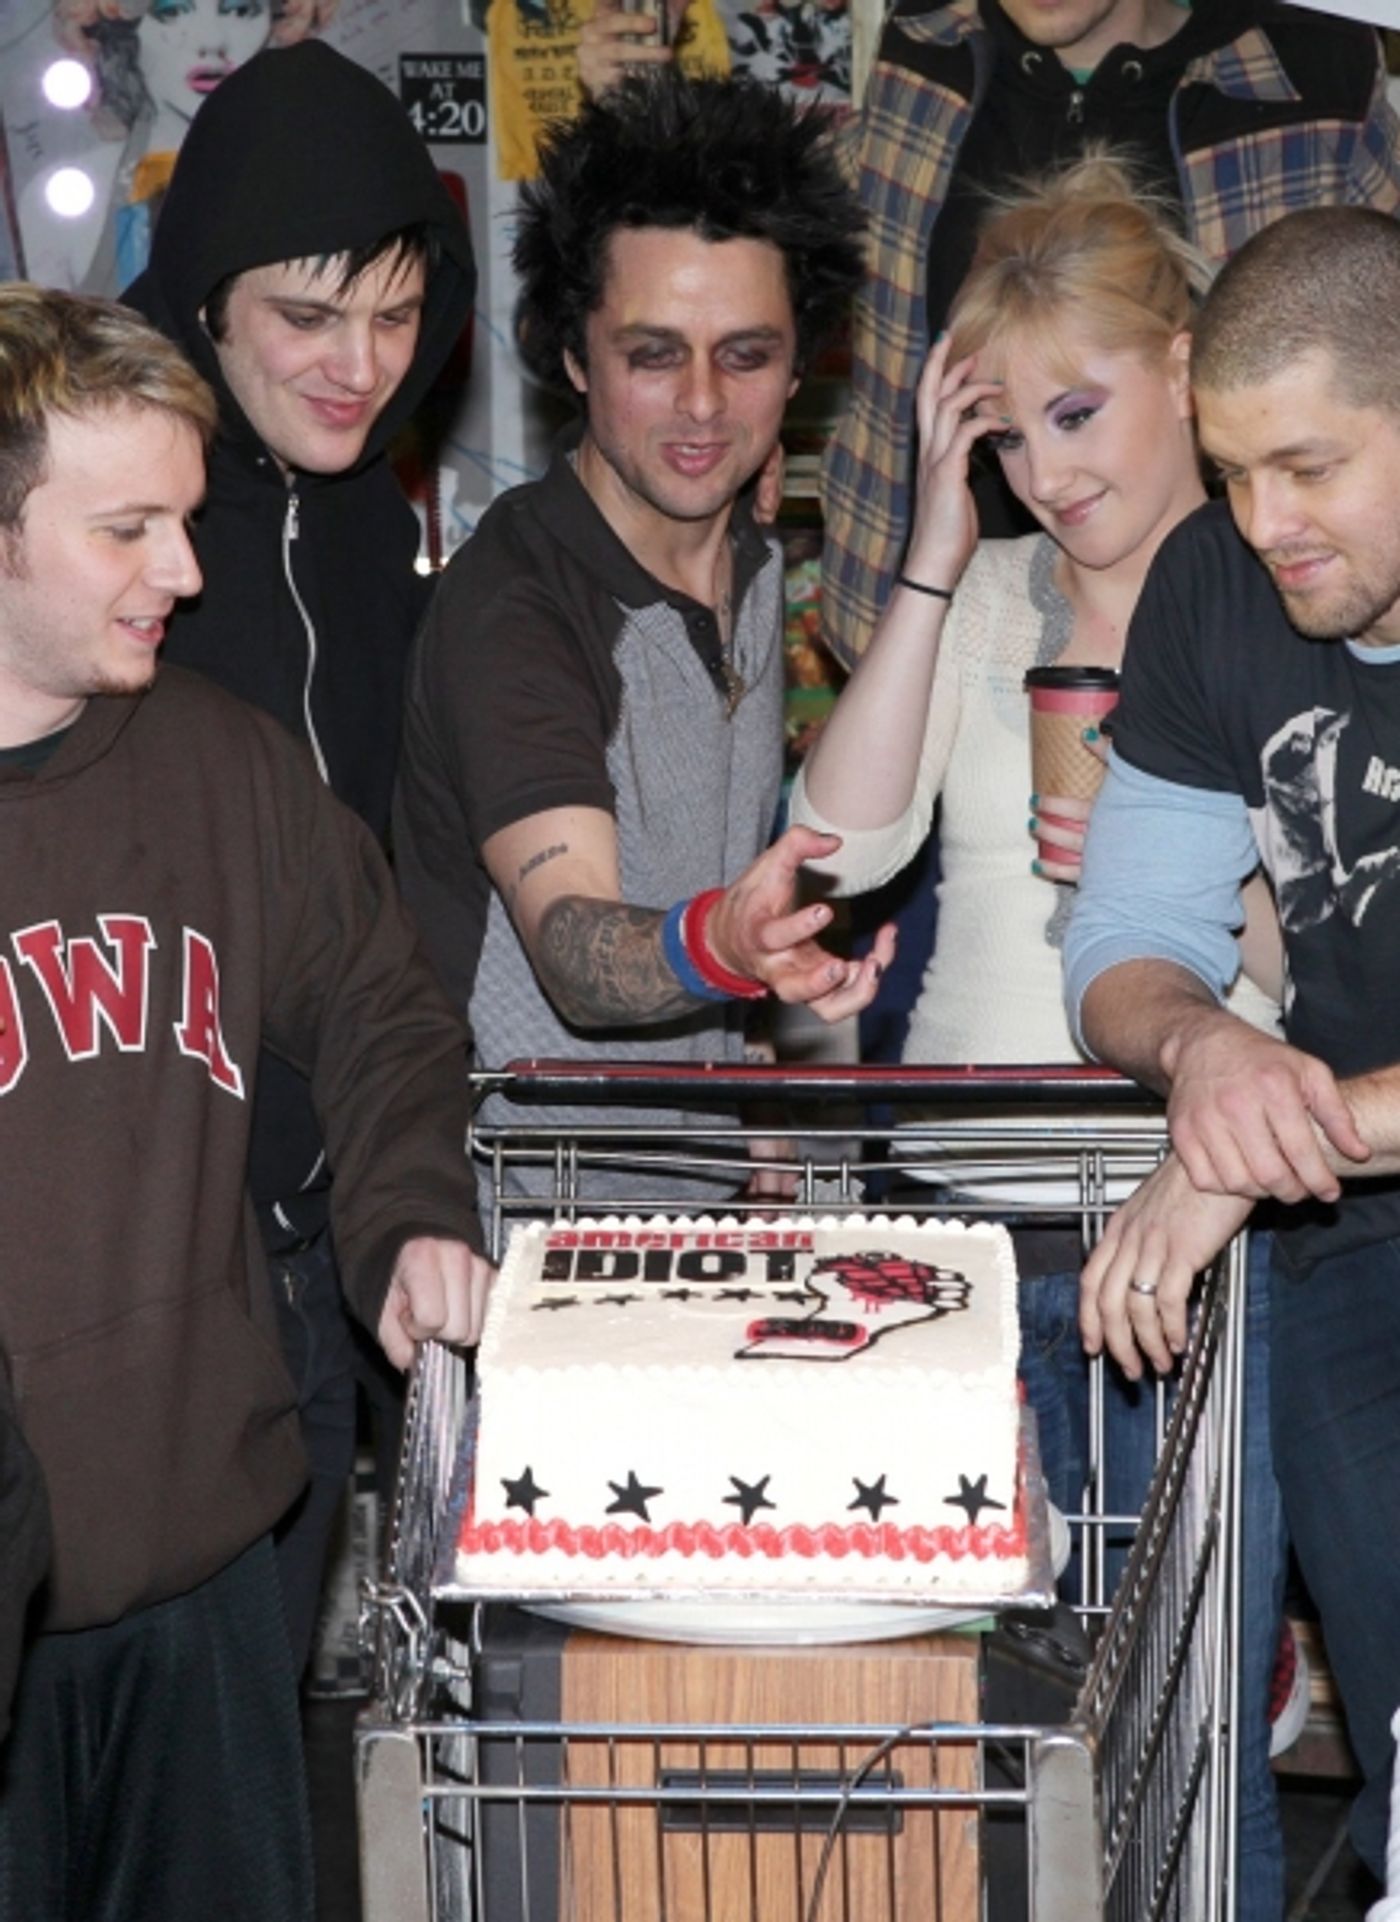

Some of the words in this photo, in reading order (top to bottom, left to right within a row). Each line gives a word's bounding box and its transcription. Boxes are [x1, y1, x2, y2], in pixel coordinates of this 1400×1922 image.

[402, 60, 453, 78] WAKE
[455, 60, 483, 78] ME
[429, 81, 456, 99] AT
[408, 100, 485, 136] 4:20
[544, 1230, 814, 1248] american
[541, 1248, 815, 1283] IDIOT
